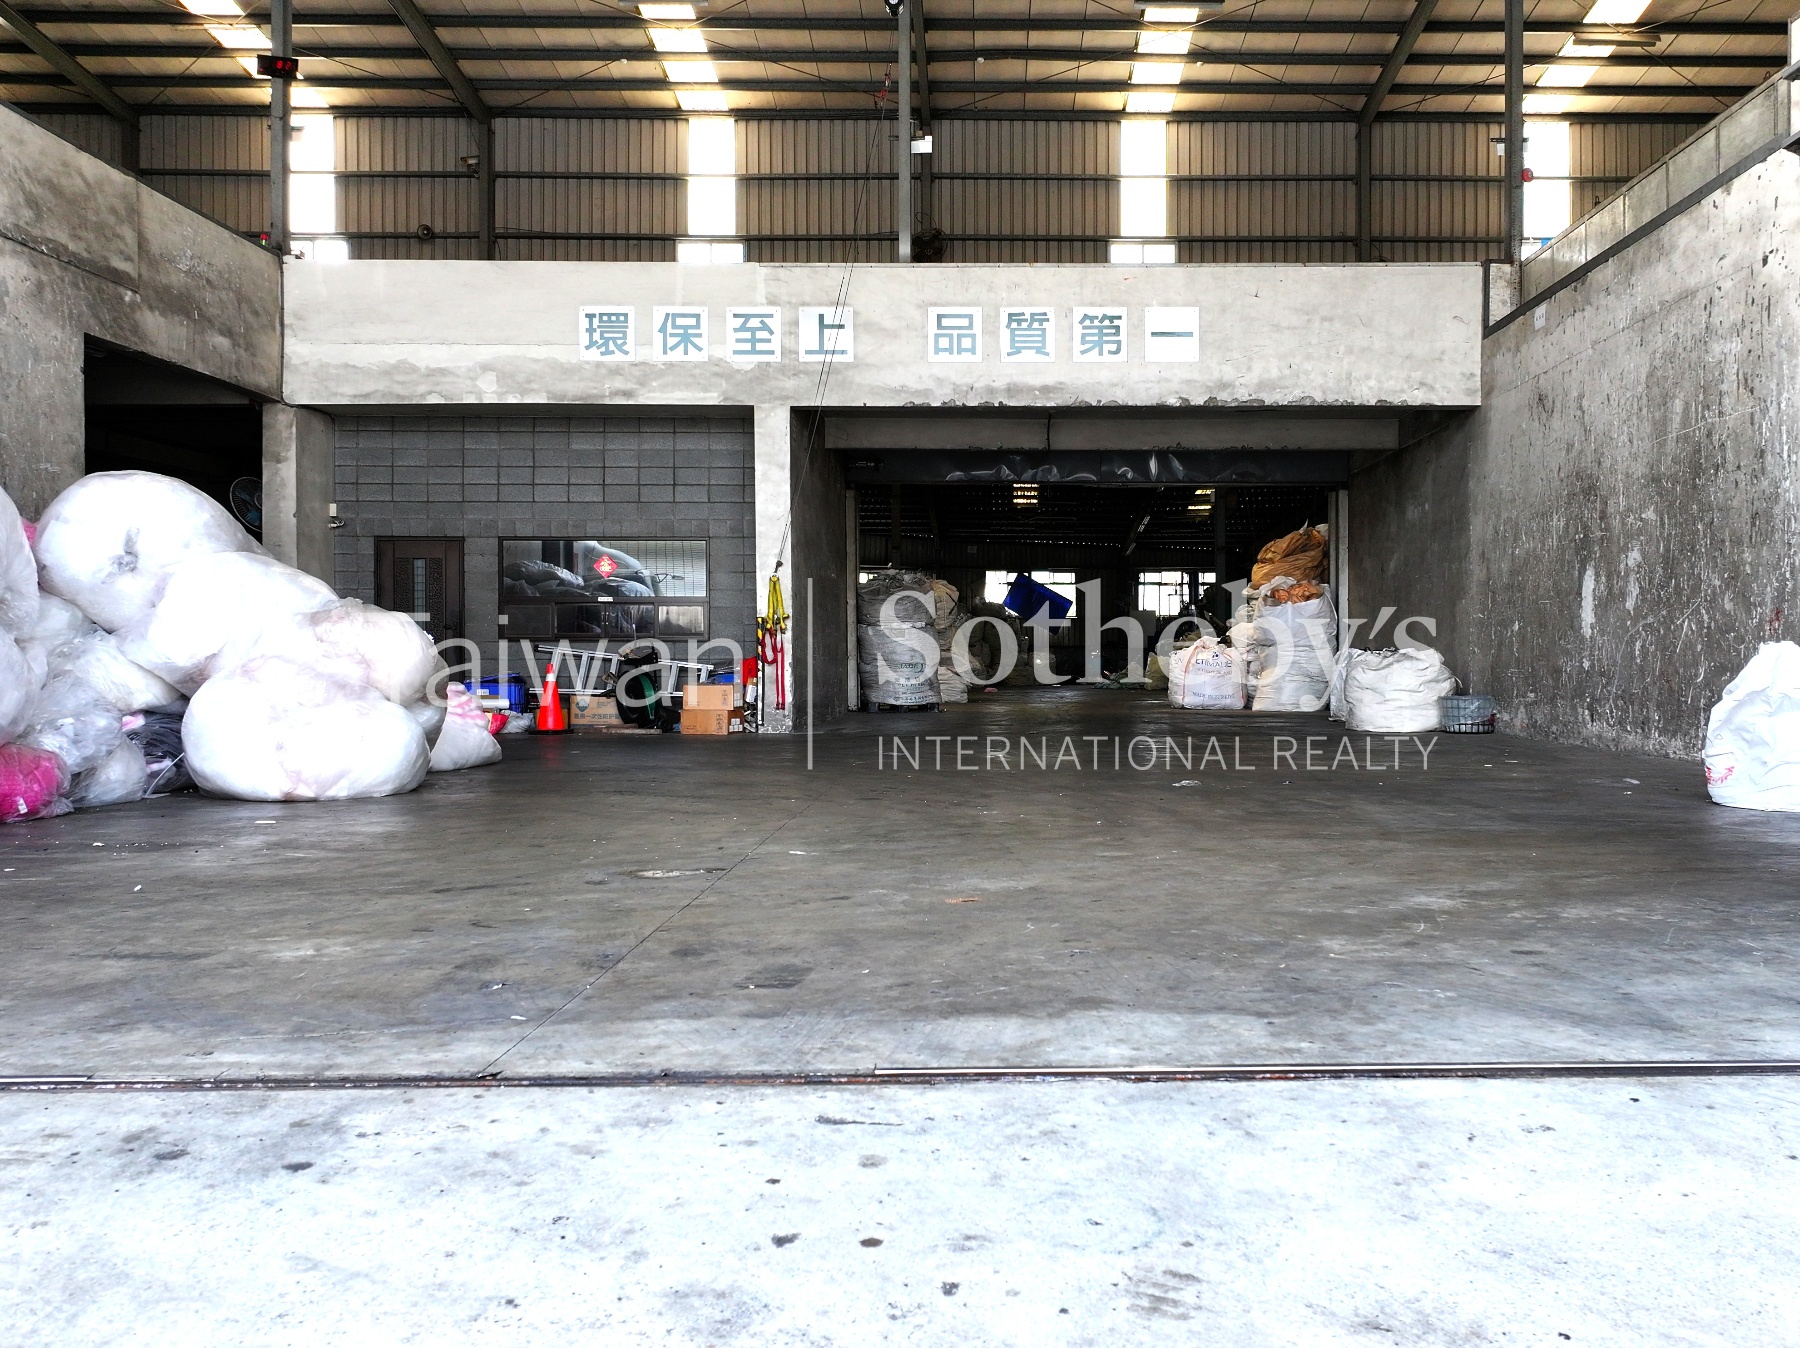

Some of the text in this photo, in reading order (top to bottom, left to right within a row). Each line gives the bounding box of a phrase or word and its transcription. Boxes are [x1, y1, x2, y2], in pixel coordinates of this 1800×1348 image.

[584, 312, 1194, 356] 環保至上 品質第一
